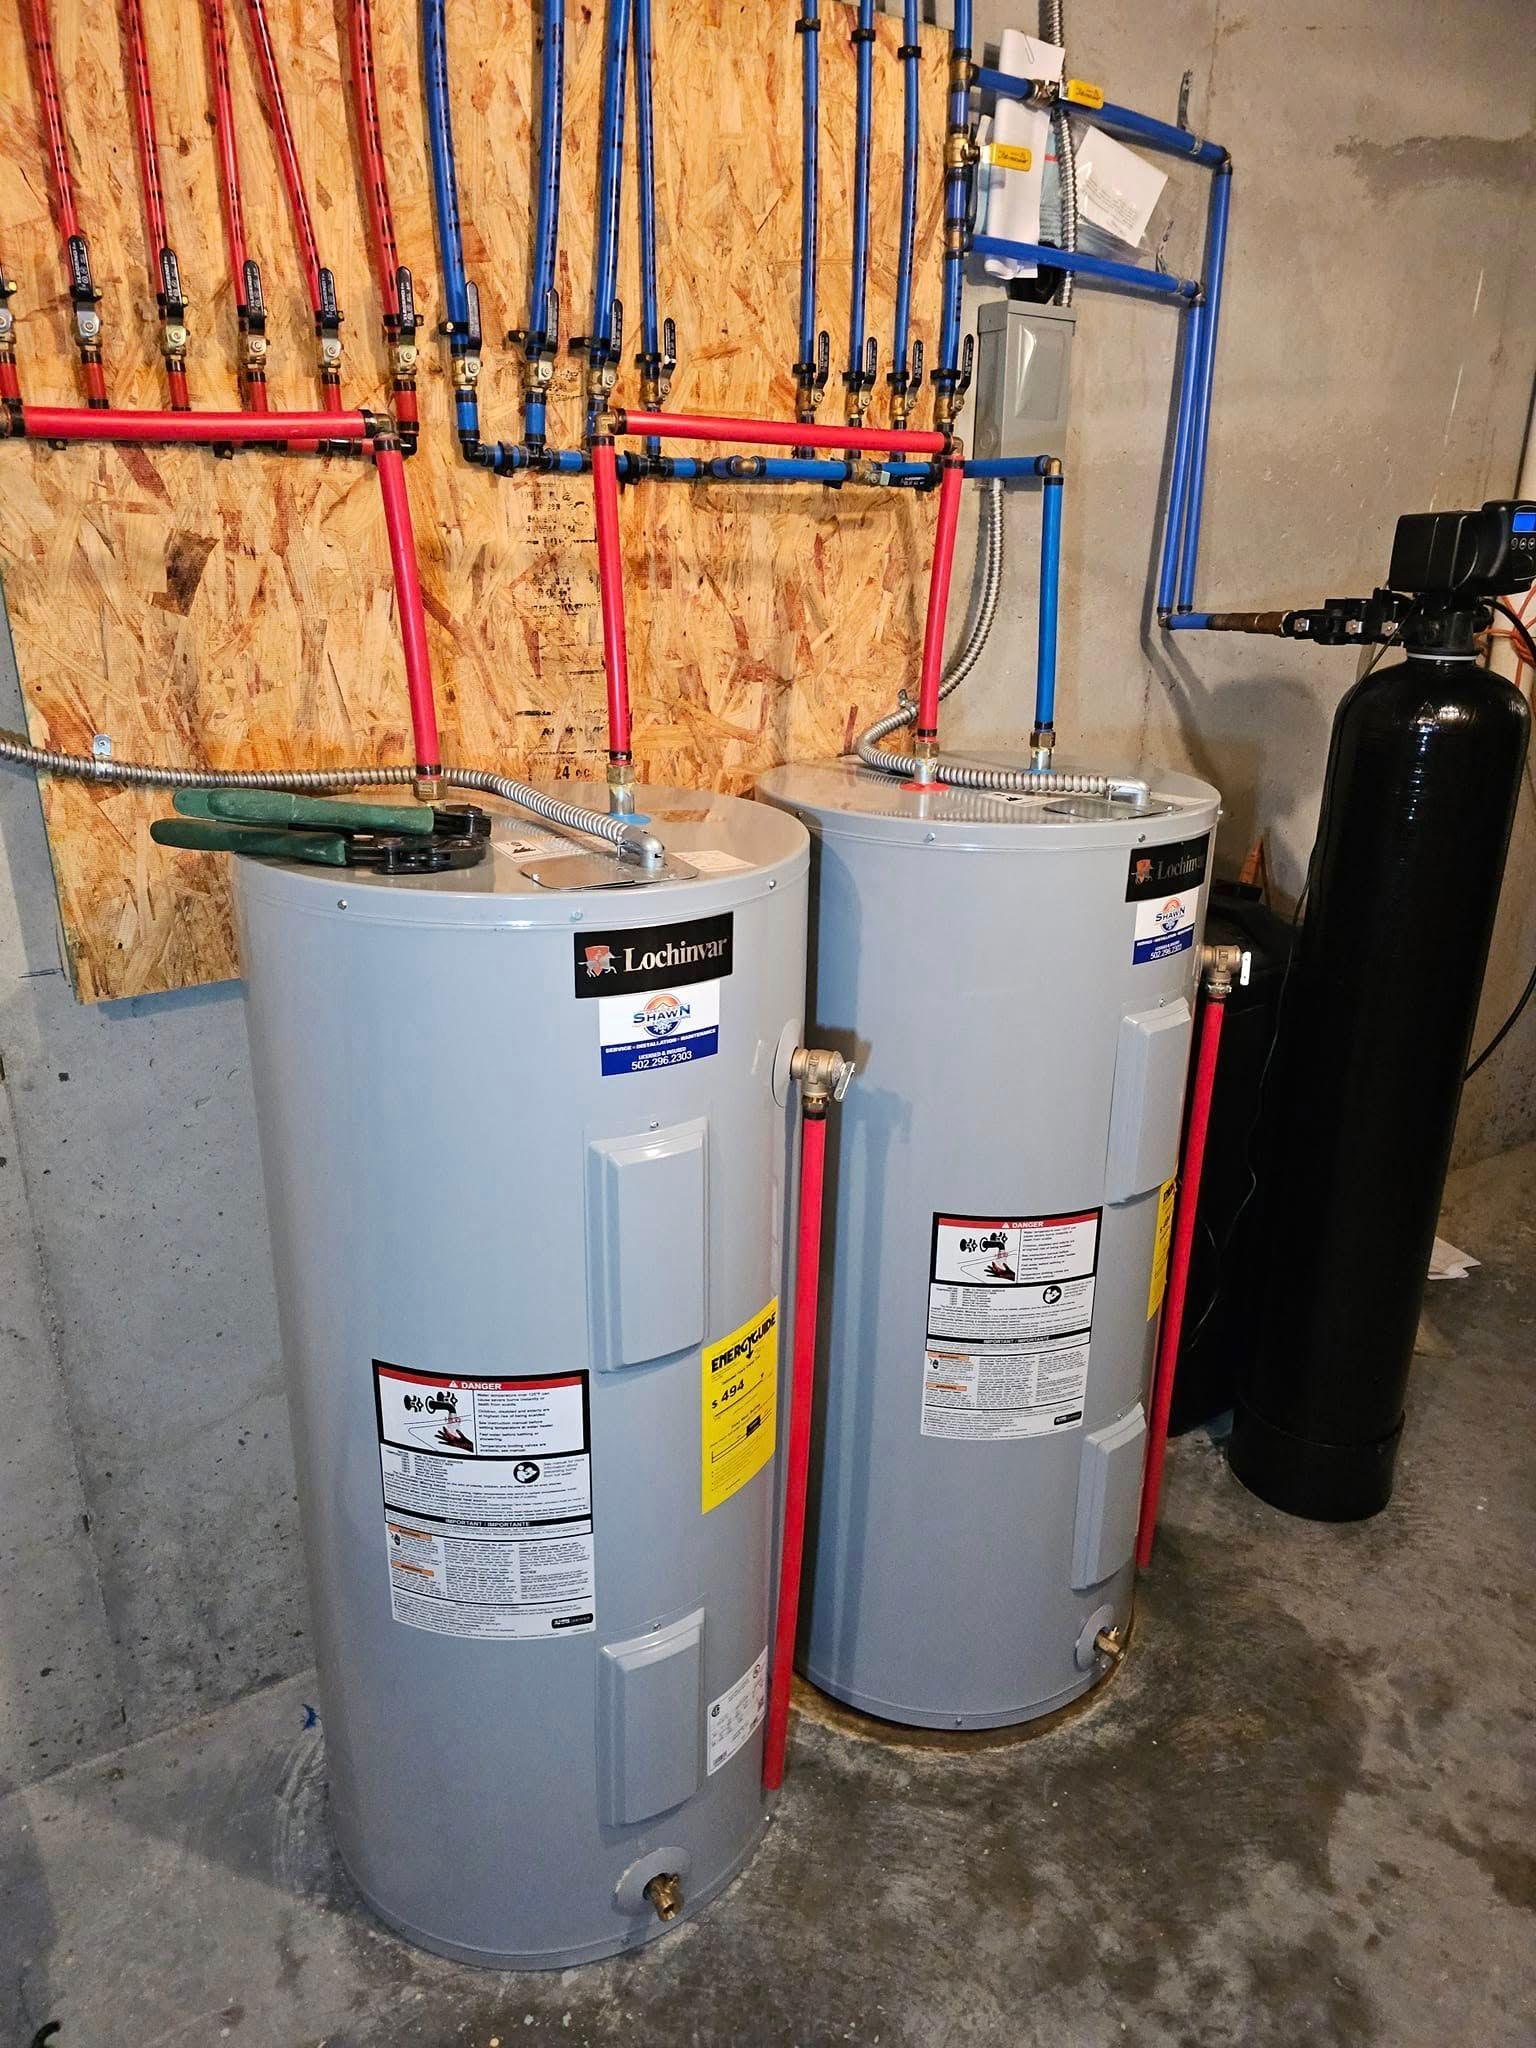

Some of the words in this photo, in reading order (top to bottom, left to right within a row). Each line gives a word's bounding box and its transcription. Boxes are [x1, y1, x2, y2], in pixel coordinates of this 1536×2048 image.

[1158, 854, 1205, 879] Lochinv
[1156, 905, 1186, 922] SHAWN
[623, 938, 728, 972] Lochinvar
[633, 1004, 691, 1023] SHAWN
[632, 1051, 692, 1070] 502.296.2303
[1012, 1221, 1044, 1229] DANGER
[712, 1312, 776, 1372] ENERGYGUIDE
[461, 1382, 502, 1390] DANGER
[721, 1379, 744, 1402] 494
